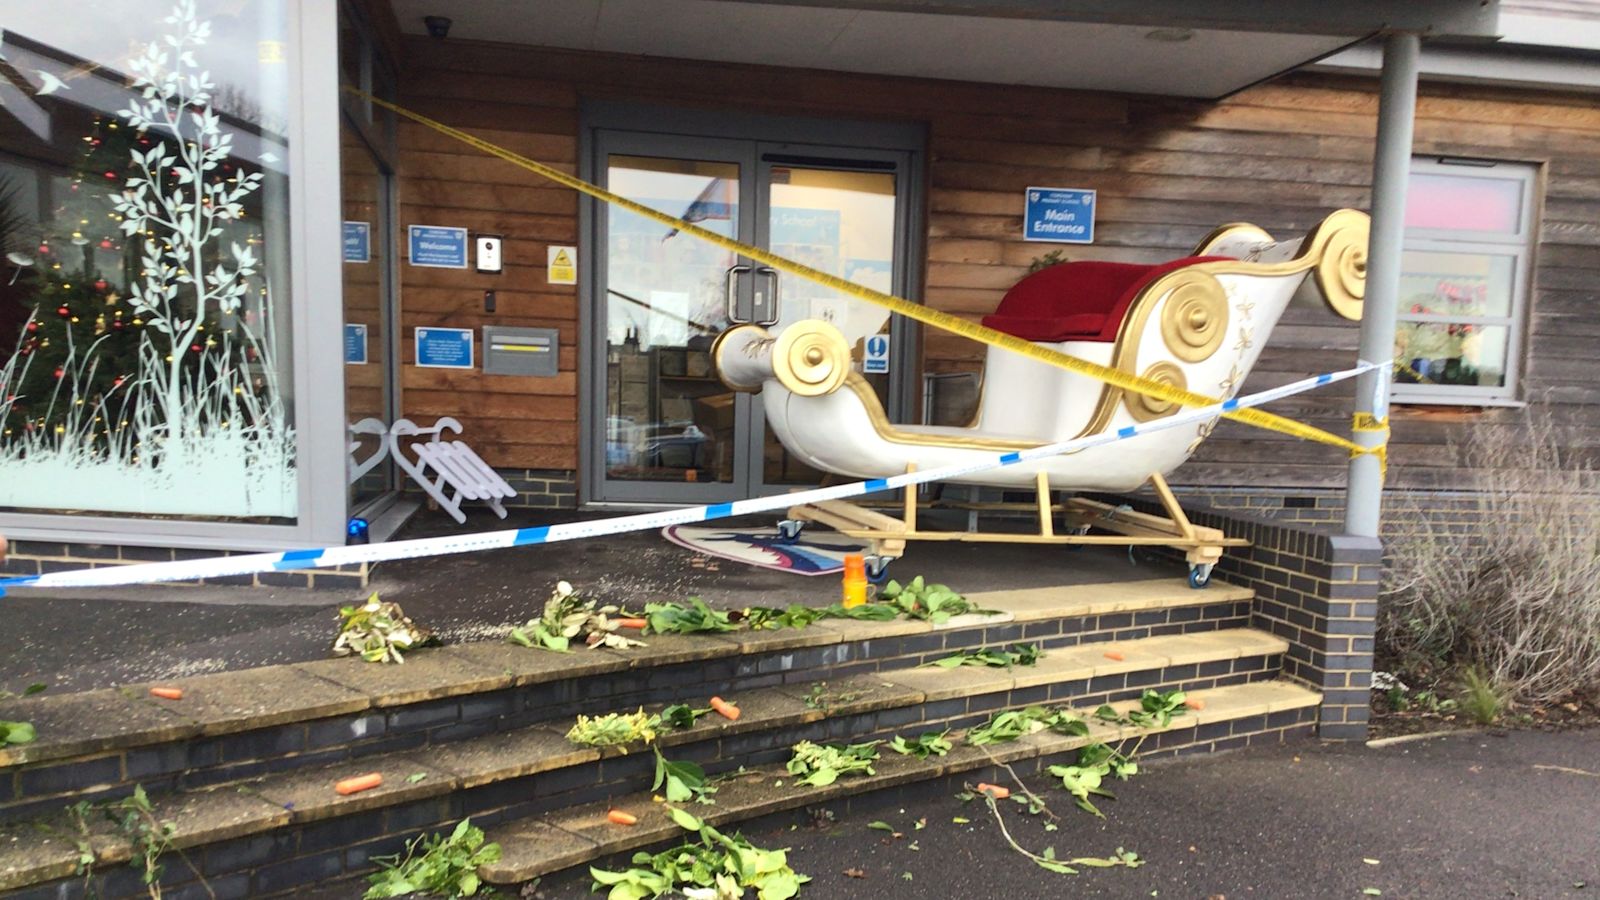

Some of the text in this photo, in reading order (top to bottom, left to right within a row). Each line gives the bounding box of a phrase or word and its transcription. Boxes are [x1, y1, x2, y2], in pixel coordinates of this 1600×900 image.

[1044, 209, 1076, 222] Main
[1033, 221, 1086, 234] Entrance
[419, 242, 457, 251] Welcome
